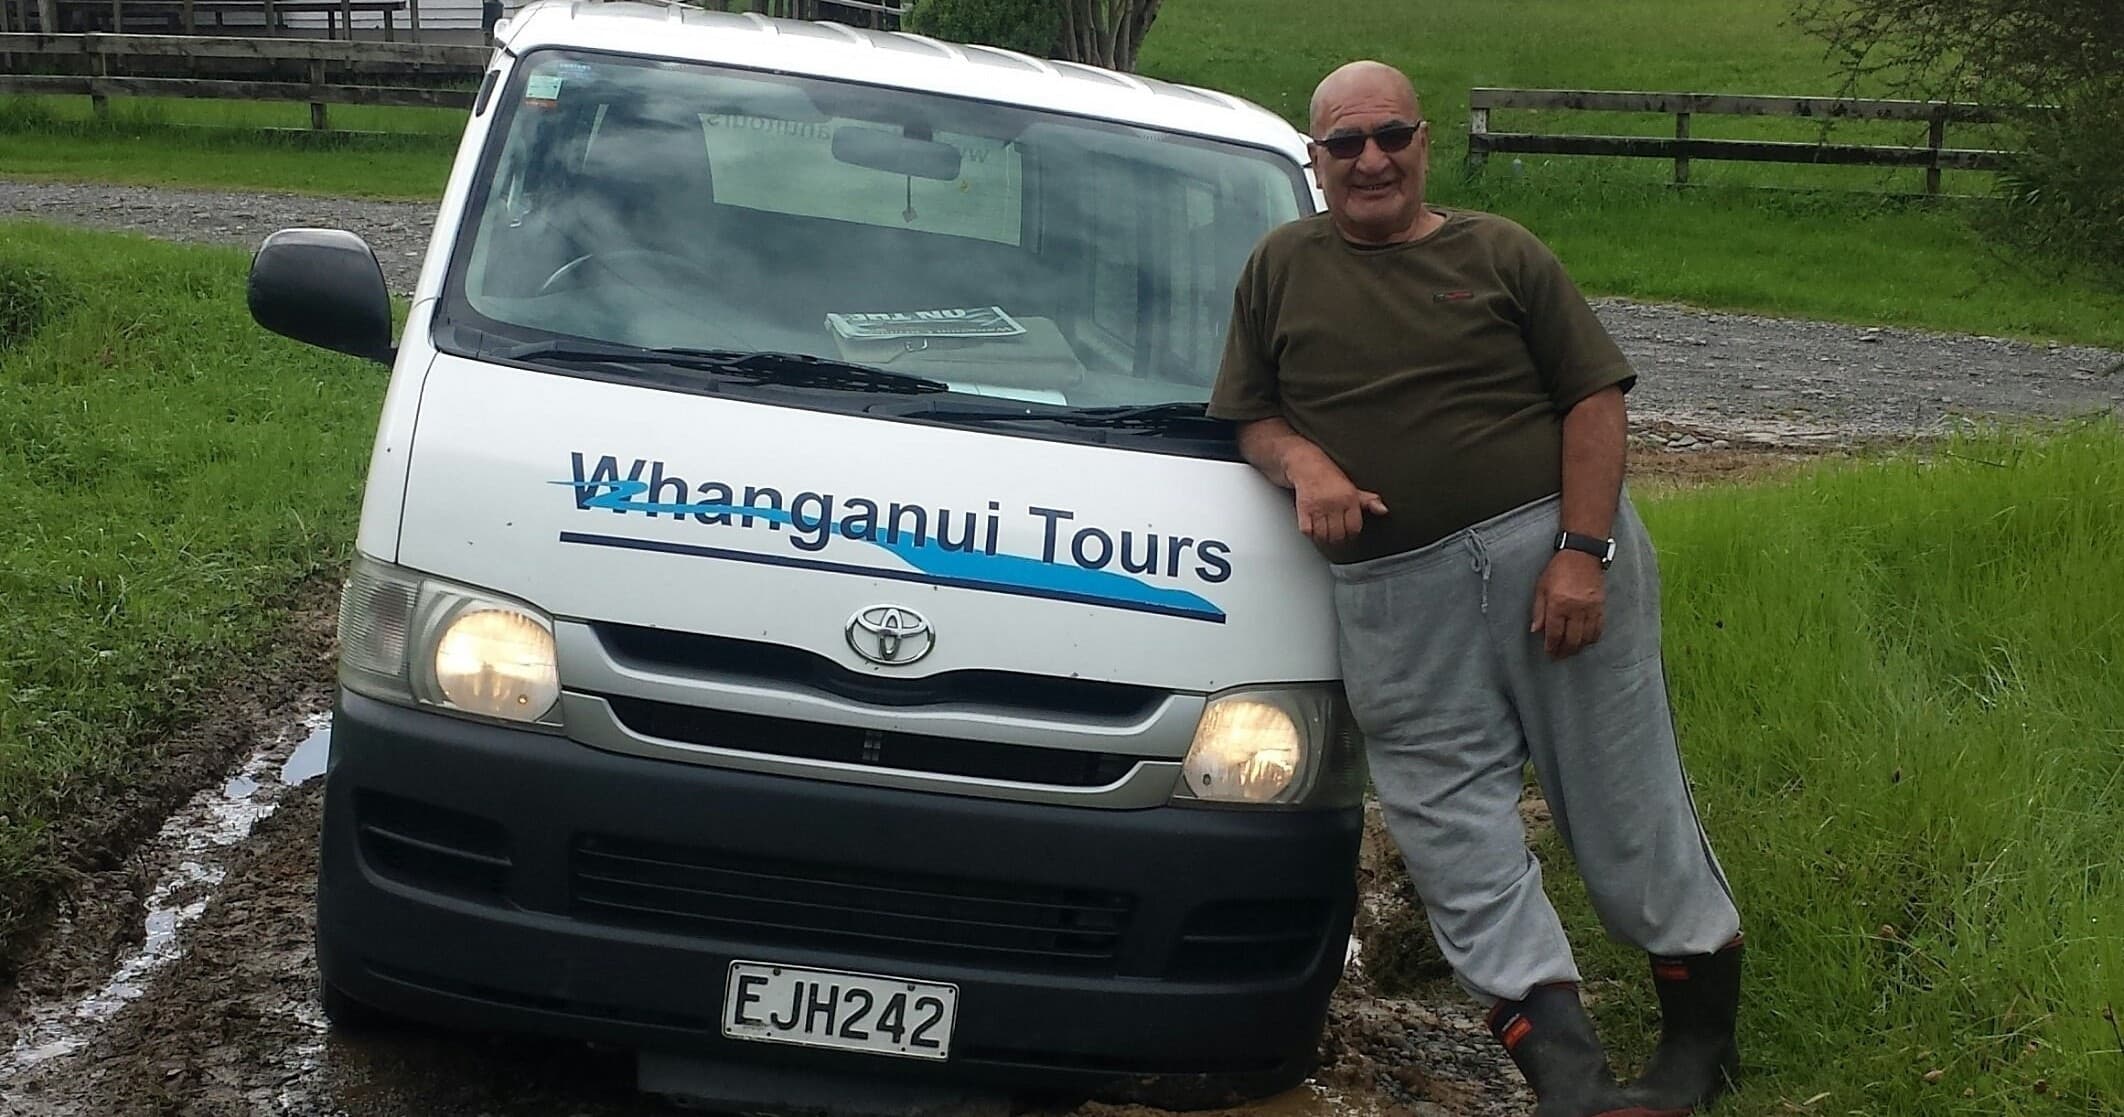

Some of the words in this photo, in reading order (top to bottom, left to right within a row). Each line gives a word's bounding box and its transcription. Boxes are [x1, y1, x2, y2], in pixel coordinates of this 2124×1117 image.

[570, 450, 1000, 556] Whanganui
[1028, 505, 1233, 584] Tours
[734, 974, 944, 1049] EJH242
